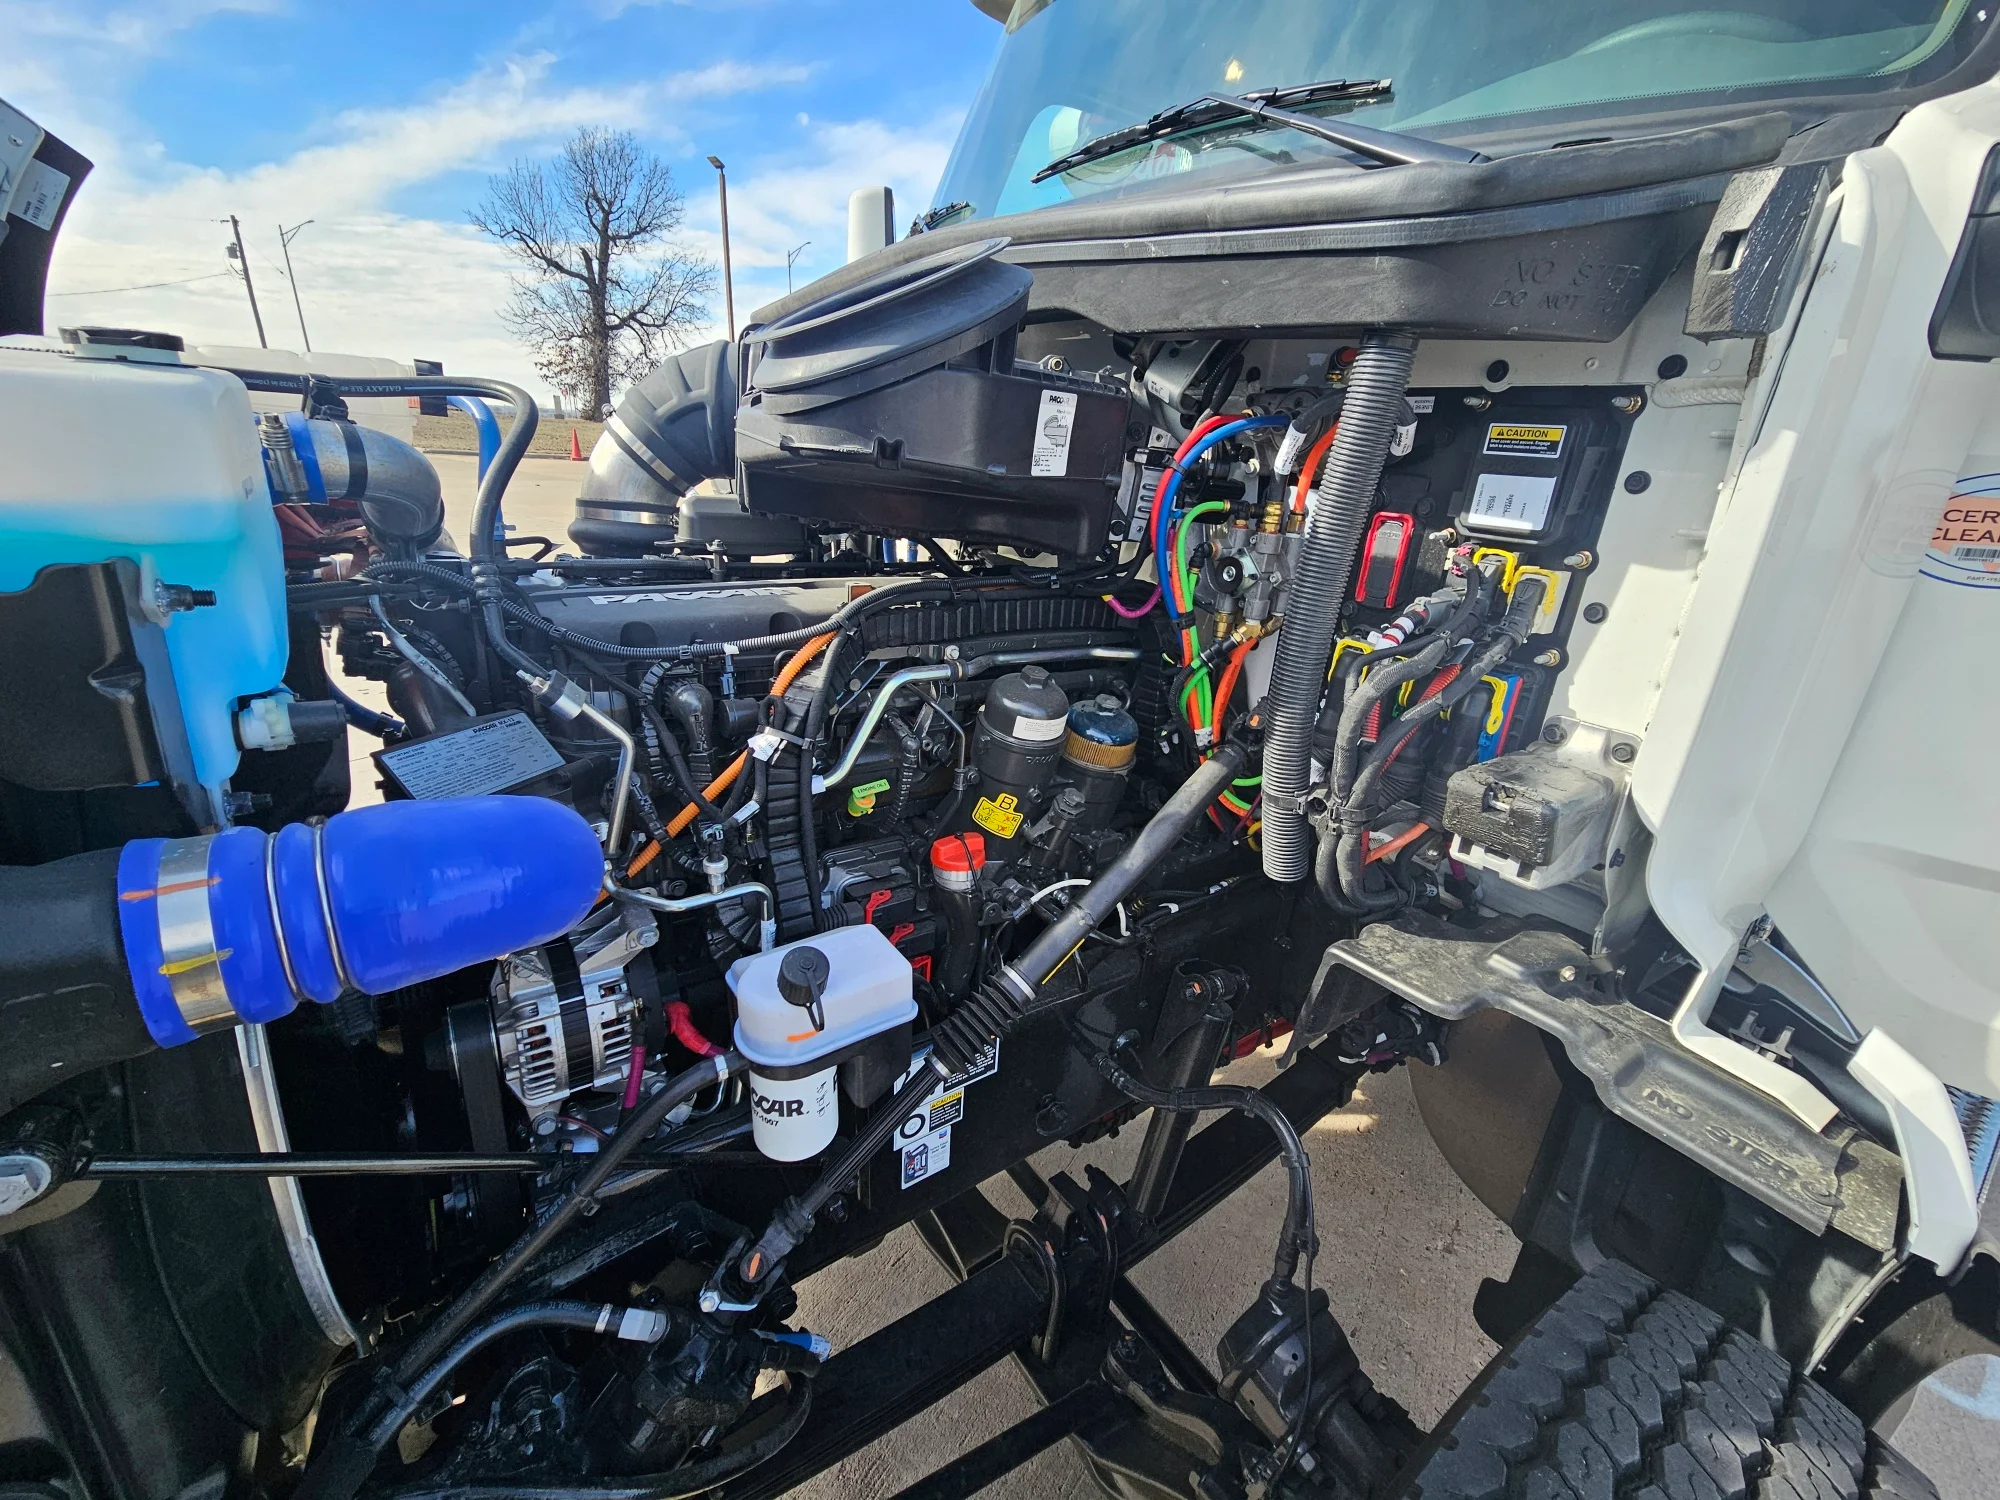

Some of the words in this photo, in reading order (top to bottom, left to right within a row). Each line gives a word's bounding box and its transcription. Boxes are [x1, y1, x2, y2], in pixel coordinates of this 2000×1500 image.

[1573, 264, 1641, 293] STEP
[1489, 289, 1528, 306] DO
[1506, 429, 1549, 438] CAUTION
[1943, 509, 2000, 524] CER
[1000, 796, 1013, 810] B
[935, 1091, 962, 1106] CAUTION
[1643, 1089, 1694, 1121] NO
[1705, 1125, 1799, 1178] STEP
